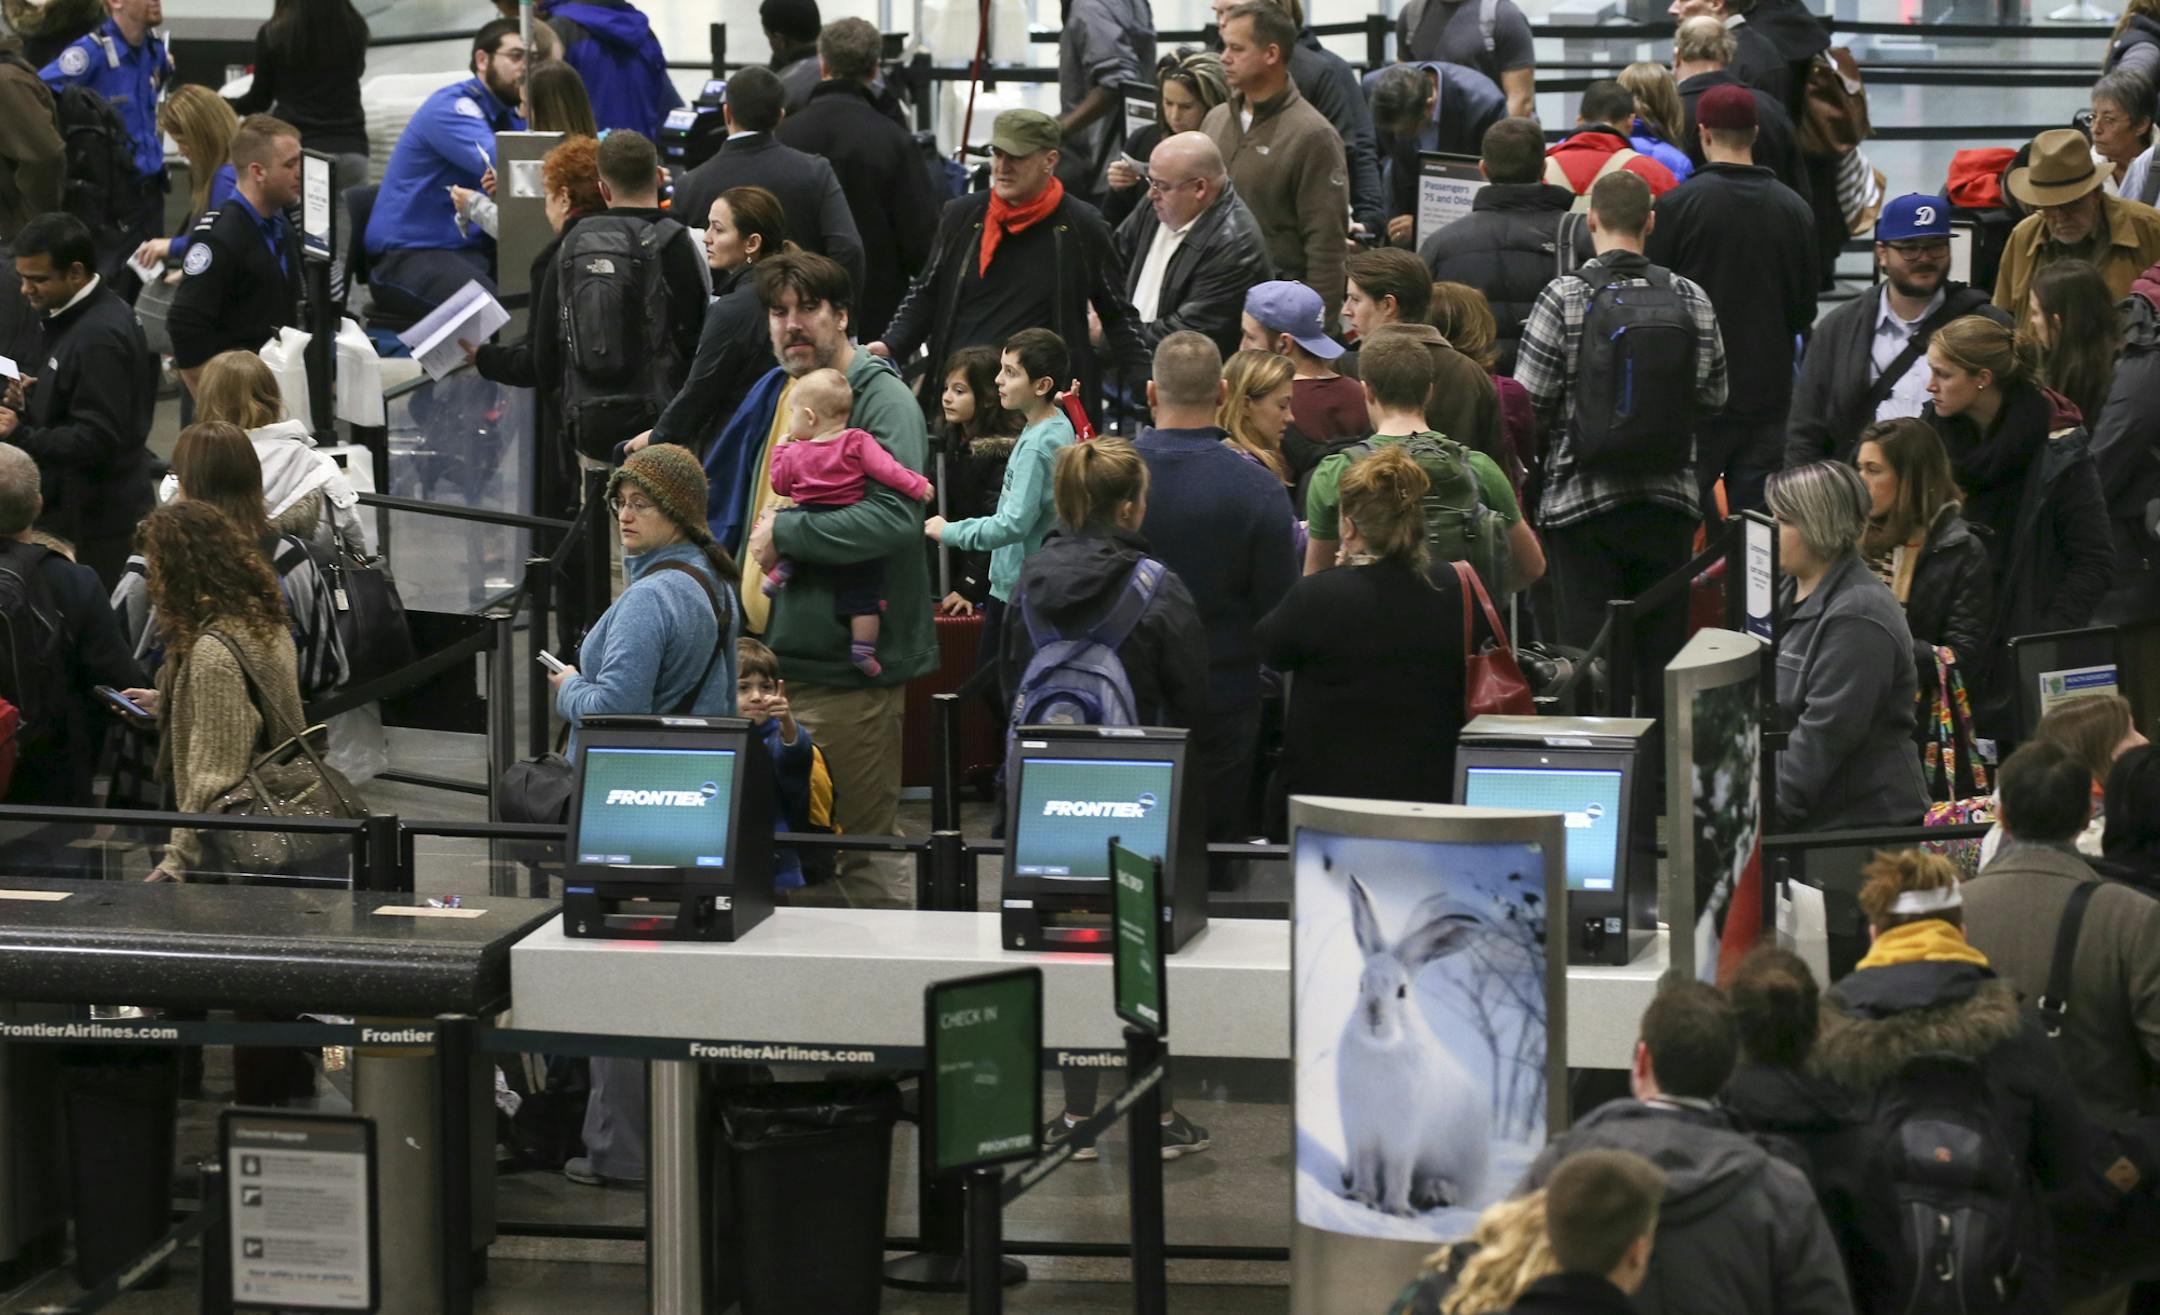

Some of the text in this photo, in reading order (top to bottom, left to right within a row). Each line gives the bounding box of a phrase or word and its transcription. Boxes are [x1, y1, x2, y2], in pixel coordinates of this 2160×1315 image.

[1424, 193, 1434, 202] 75
[1454, 196, 1473, 206] Olde
[1913, 206, 1937, 226] D
[605, 789, 707, 806] FRONTIER
[1043, 800, 1145, 818] FRONTIER
[940, 1006, 998, 1029] CHECK IN
[362, 1028, 435, 1042] Frontier
[690, 1043, 875, 1062] FrontierAirlines.com
